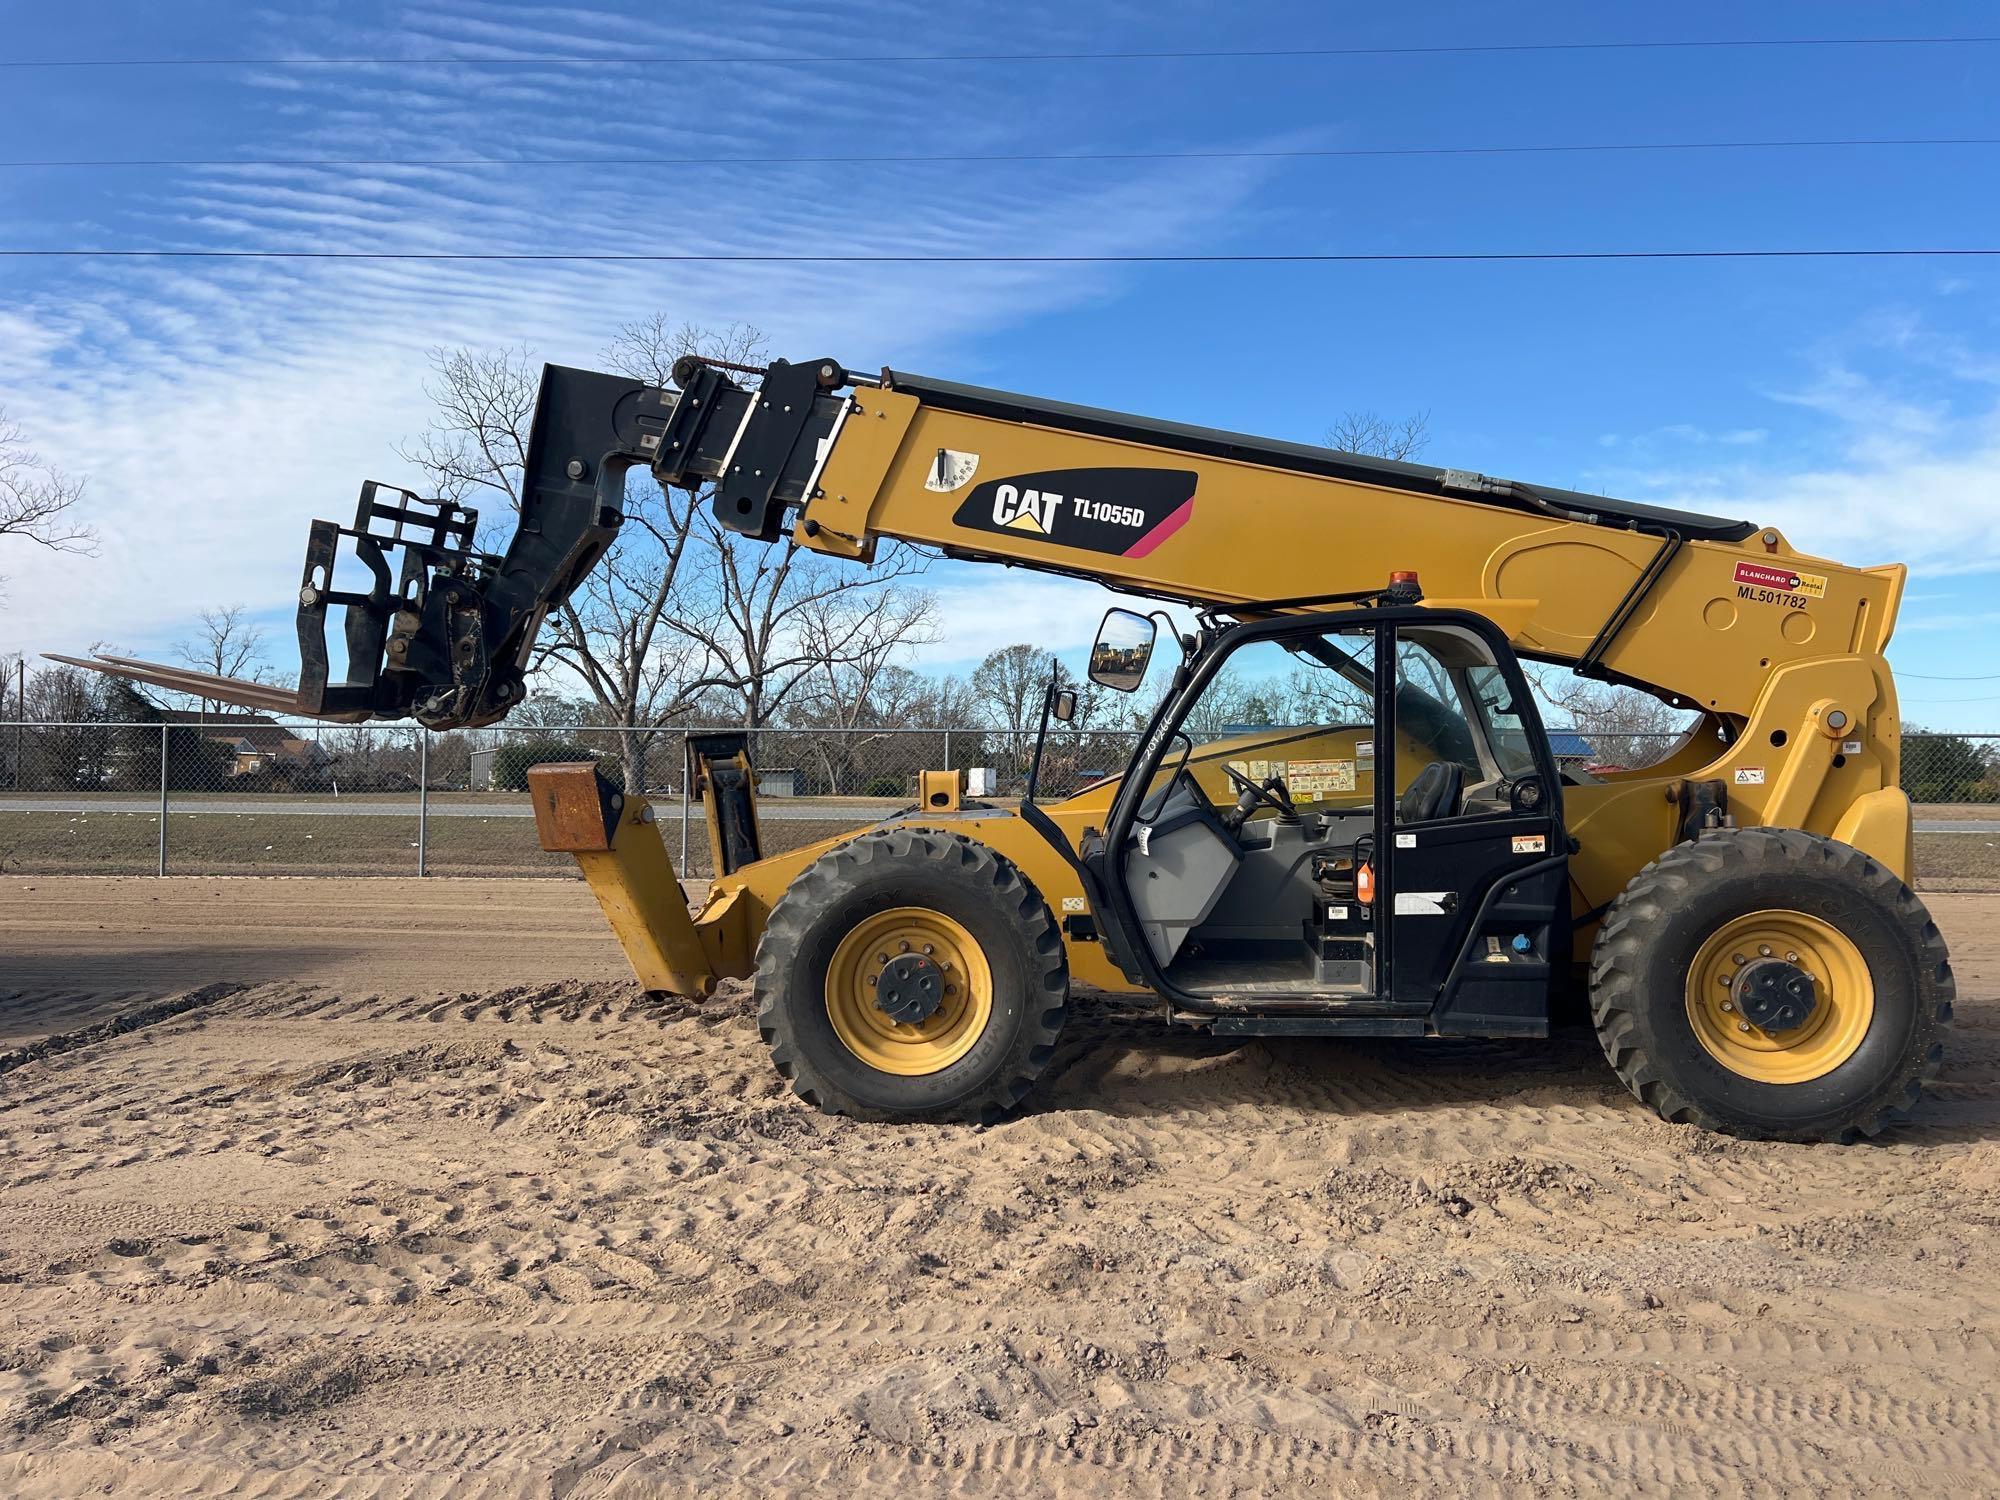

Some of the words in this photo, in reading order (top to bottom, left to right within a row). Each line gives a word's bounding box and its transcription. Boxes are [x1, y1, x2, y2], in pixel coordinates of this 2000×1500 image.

[992, 484, 1063, 535] CAT
[1073, 497, 1145, 528] TL1055D
[1740, 569, 1786, 583] BLANCHARD
[1801, 580, 1823, 591] Rental
[1737, 585, 1807, 610] ML501782
